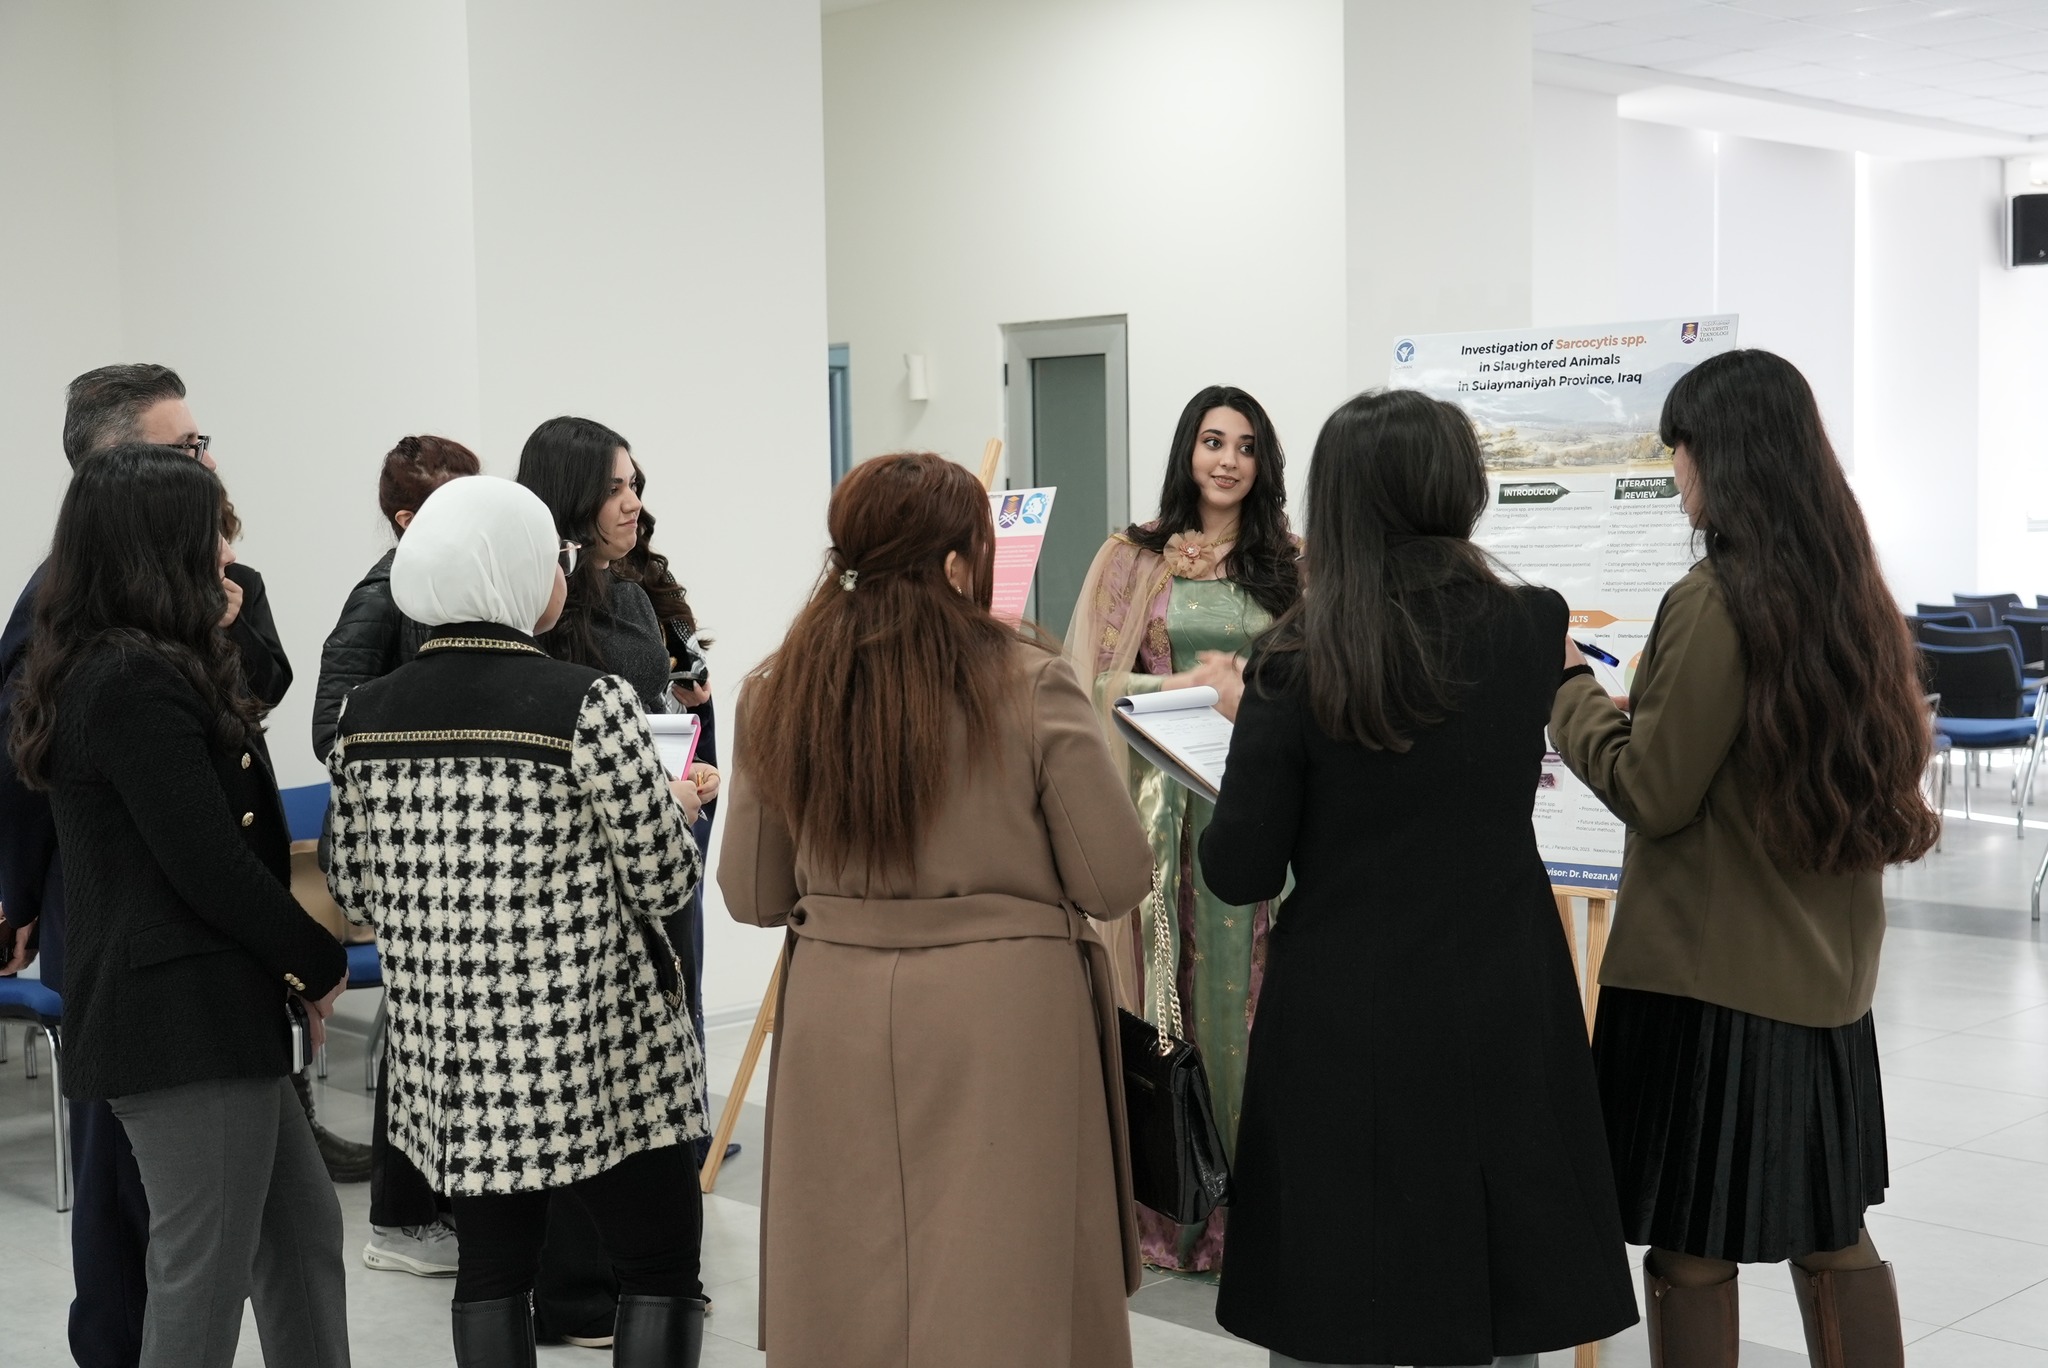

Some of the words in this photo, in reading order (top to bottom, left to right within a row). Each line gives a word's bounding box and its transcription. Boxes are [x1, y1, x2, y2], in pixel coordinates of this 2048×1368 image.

[1461, 341, 1538, 355] Investigation
[1541, 339, 1554, 350] of
[1556, 335, 1618, 350] Sarcocytis
[1621, 335, 1647, 347] spp.
[1479, 362, 1490, 372] in
[1493, 357, 1566, 372] Slaughtered
[1569, 354, 1620, 367] Animals
[1458, 381, 1469, 392] in
[1472, 376, 1556, 392] Sulaymaniyah
[1559, 374, 1614, 386] Province,
[1618, 373, 1642, 384] Iraq
[1618, 478, 1667, 487] LITERATURE
[1504, 488, 1558, 496] INTRODUCION
[1546, 868, 1567, 877] visor:
[1569, 870, 1580, 878] Dr.
[1583, 871, 1618, 881] Rezan.M
